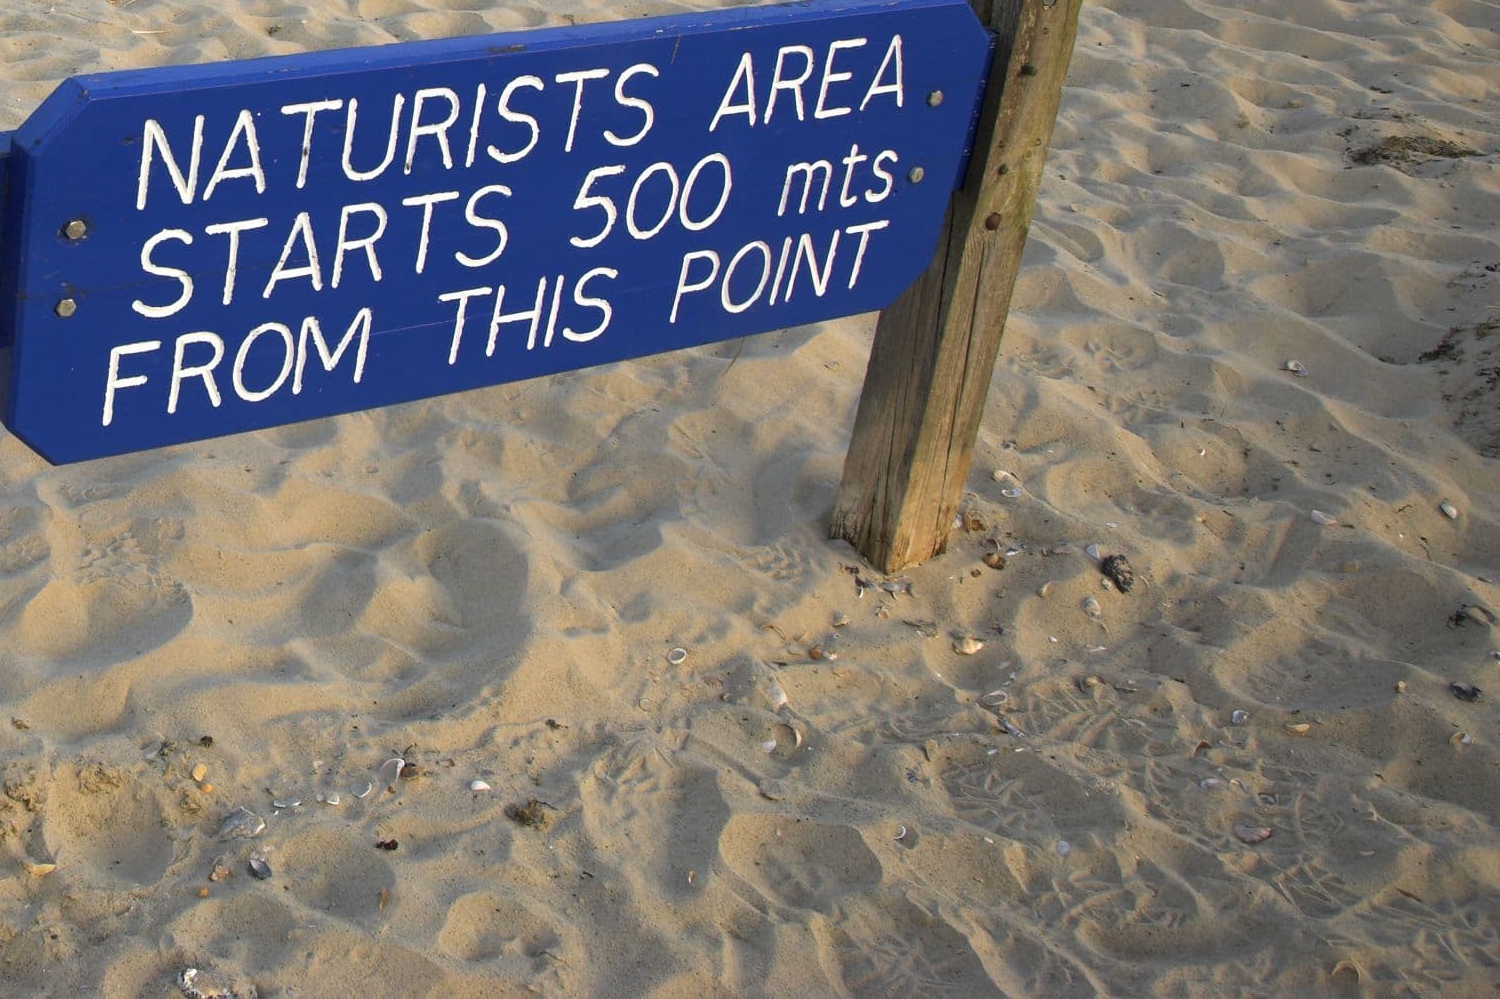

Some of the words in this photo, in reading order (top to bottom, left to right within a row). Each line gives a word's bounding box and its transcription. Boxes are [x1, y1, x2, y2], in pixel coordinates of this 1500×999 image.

[136, 62, 660, 211] NATURISTS
[708, 34, 904, 132] AREA
[131, 184, 513, 319] STARTS
[569, 152, 733, 248] 500
[777, 143, 900, 217] mts
[101, 307, 374, 427] FROM
[437, 267, 619, 365] THIS
[668, 219, 890, 324] POINT
